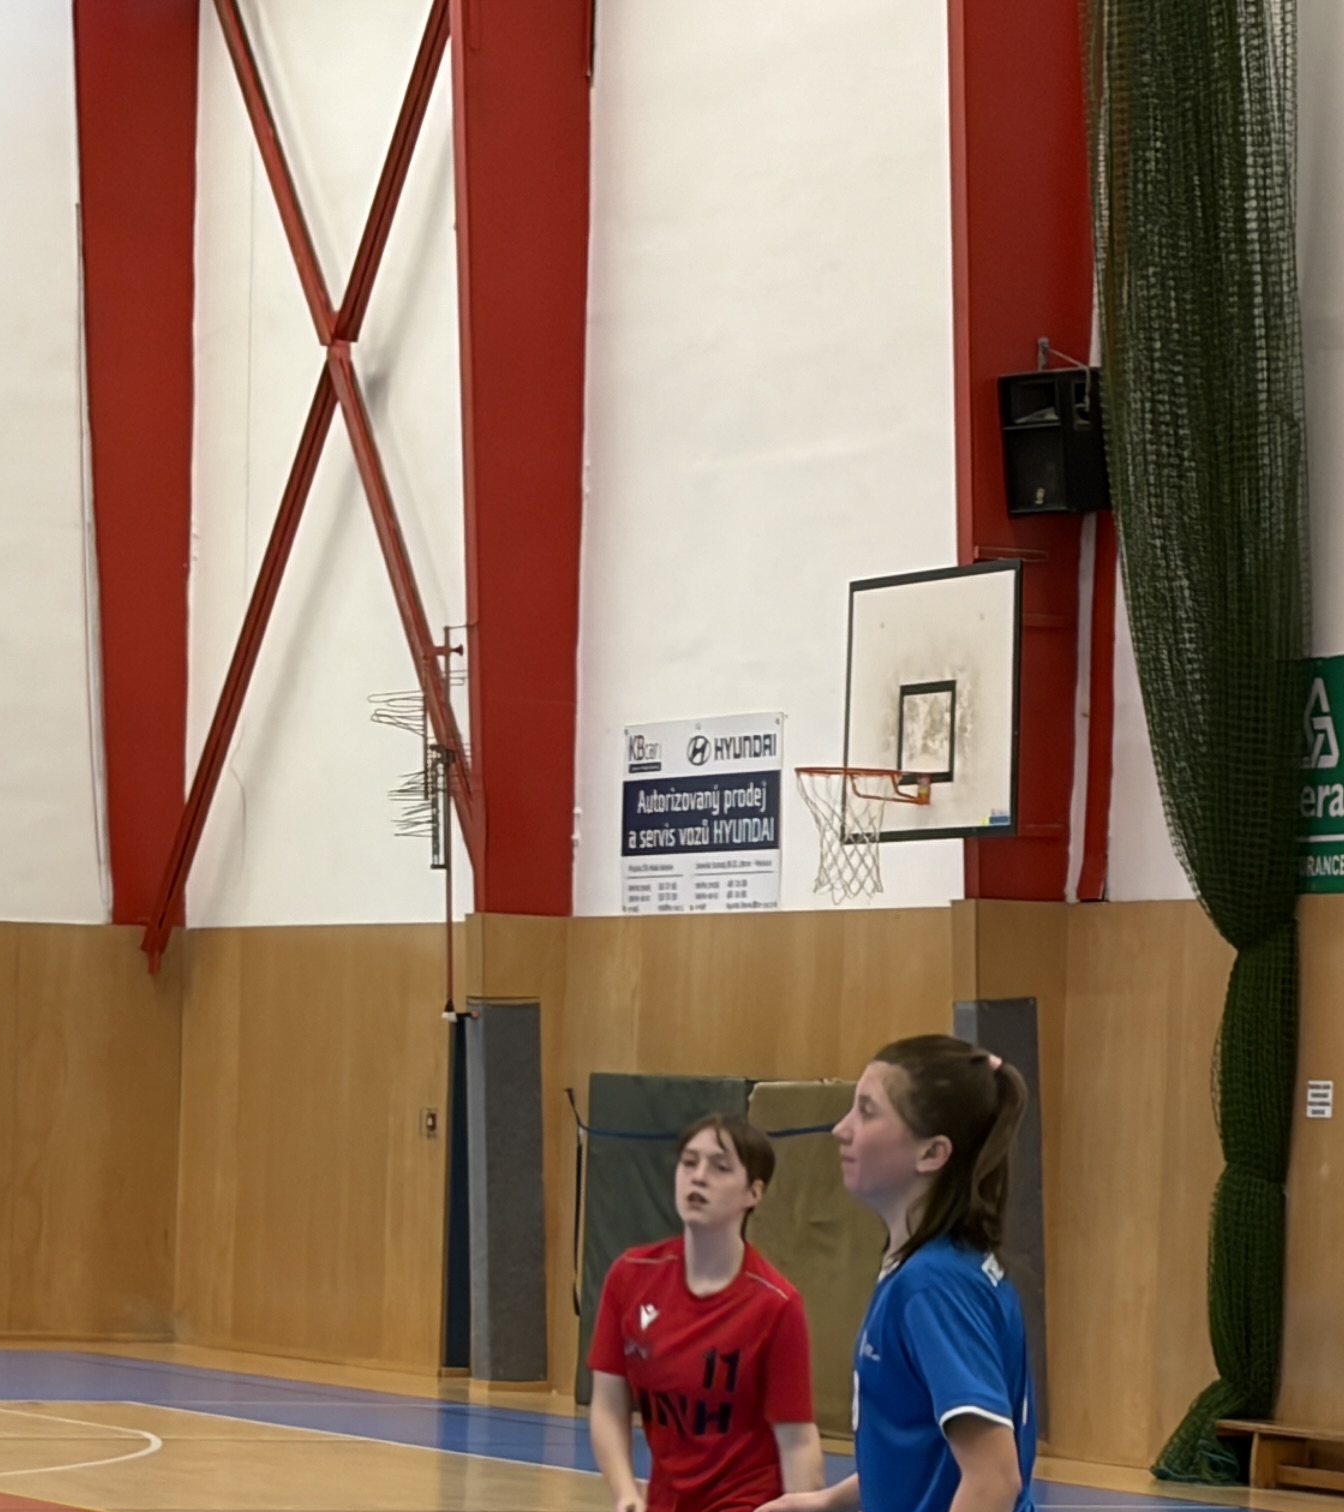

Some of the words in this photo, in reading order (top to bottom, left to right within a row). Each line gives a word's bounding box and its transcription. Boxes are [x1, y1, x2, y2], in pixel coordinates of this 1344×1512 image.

[714, 733, 777, 761] HYUNDAI
[637, 785, 720, 815] Autorizovaný
[723, 780, 767, 814] prodej
[628, 829, 637, 849] a
[639, 823, 675, 848] servis
[679, 818, 710, 846] vozů
[713, 817, 775, 844] HYUNDAI
[703, 1348, 740, 1392] 11
